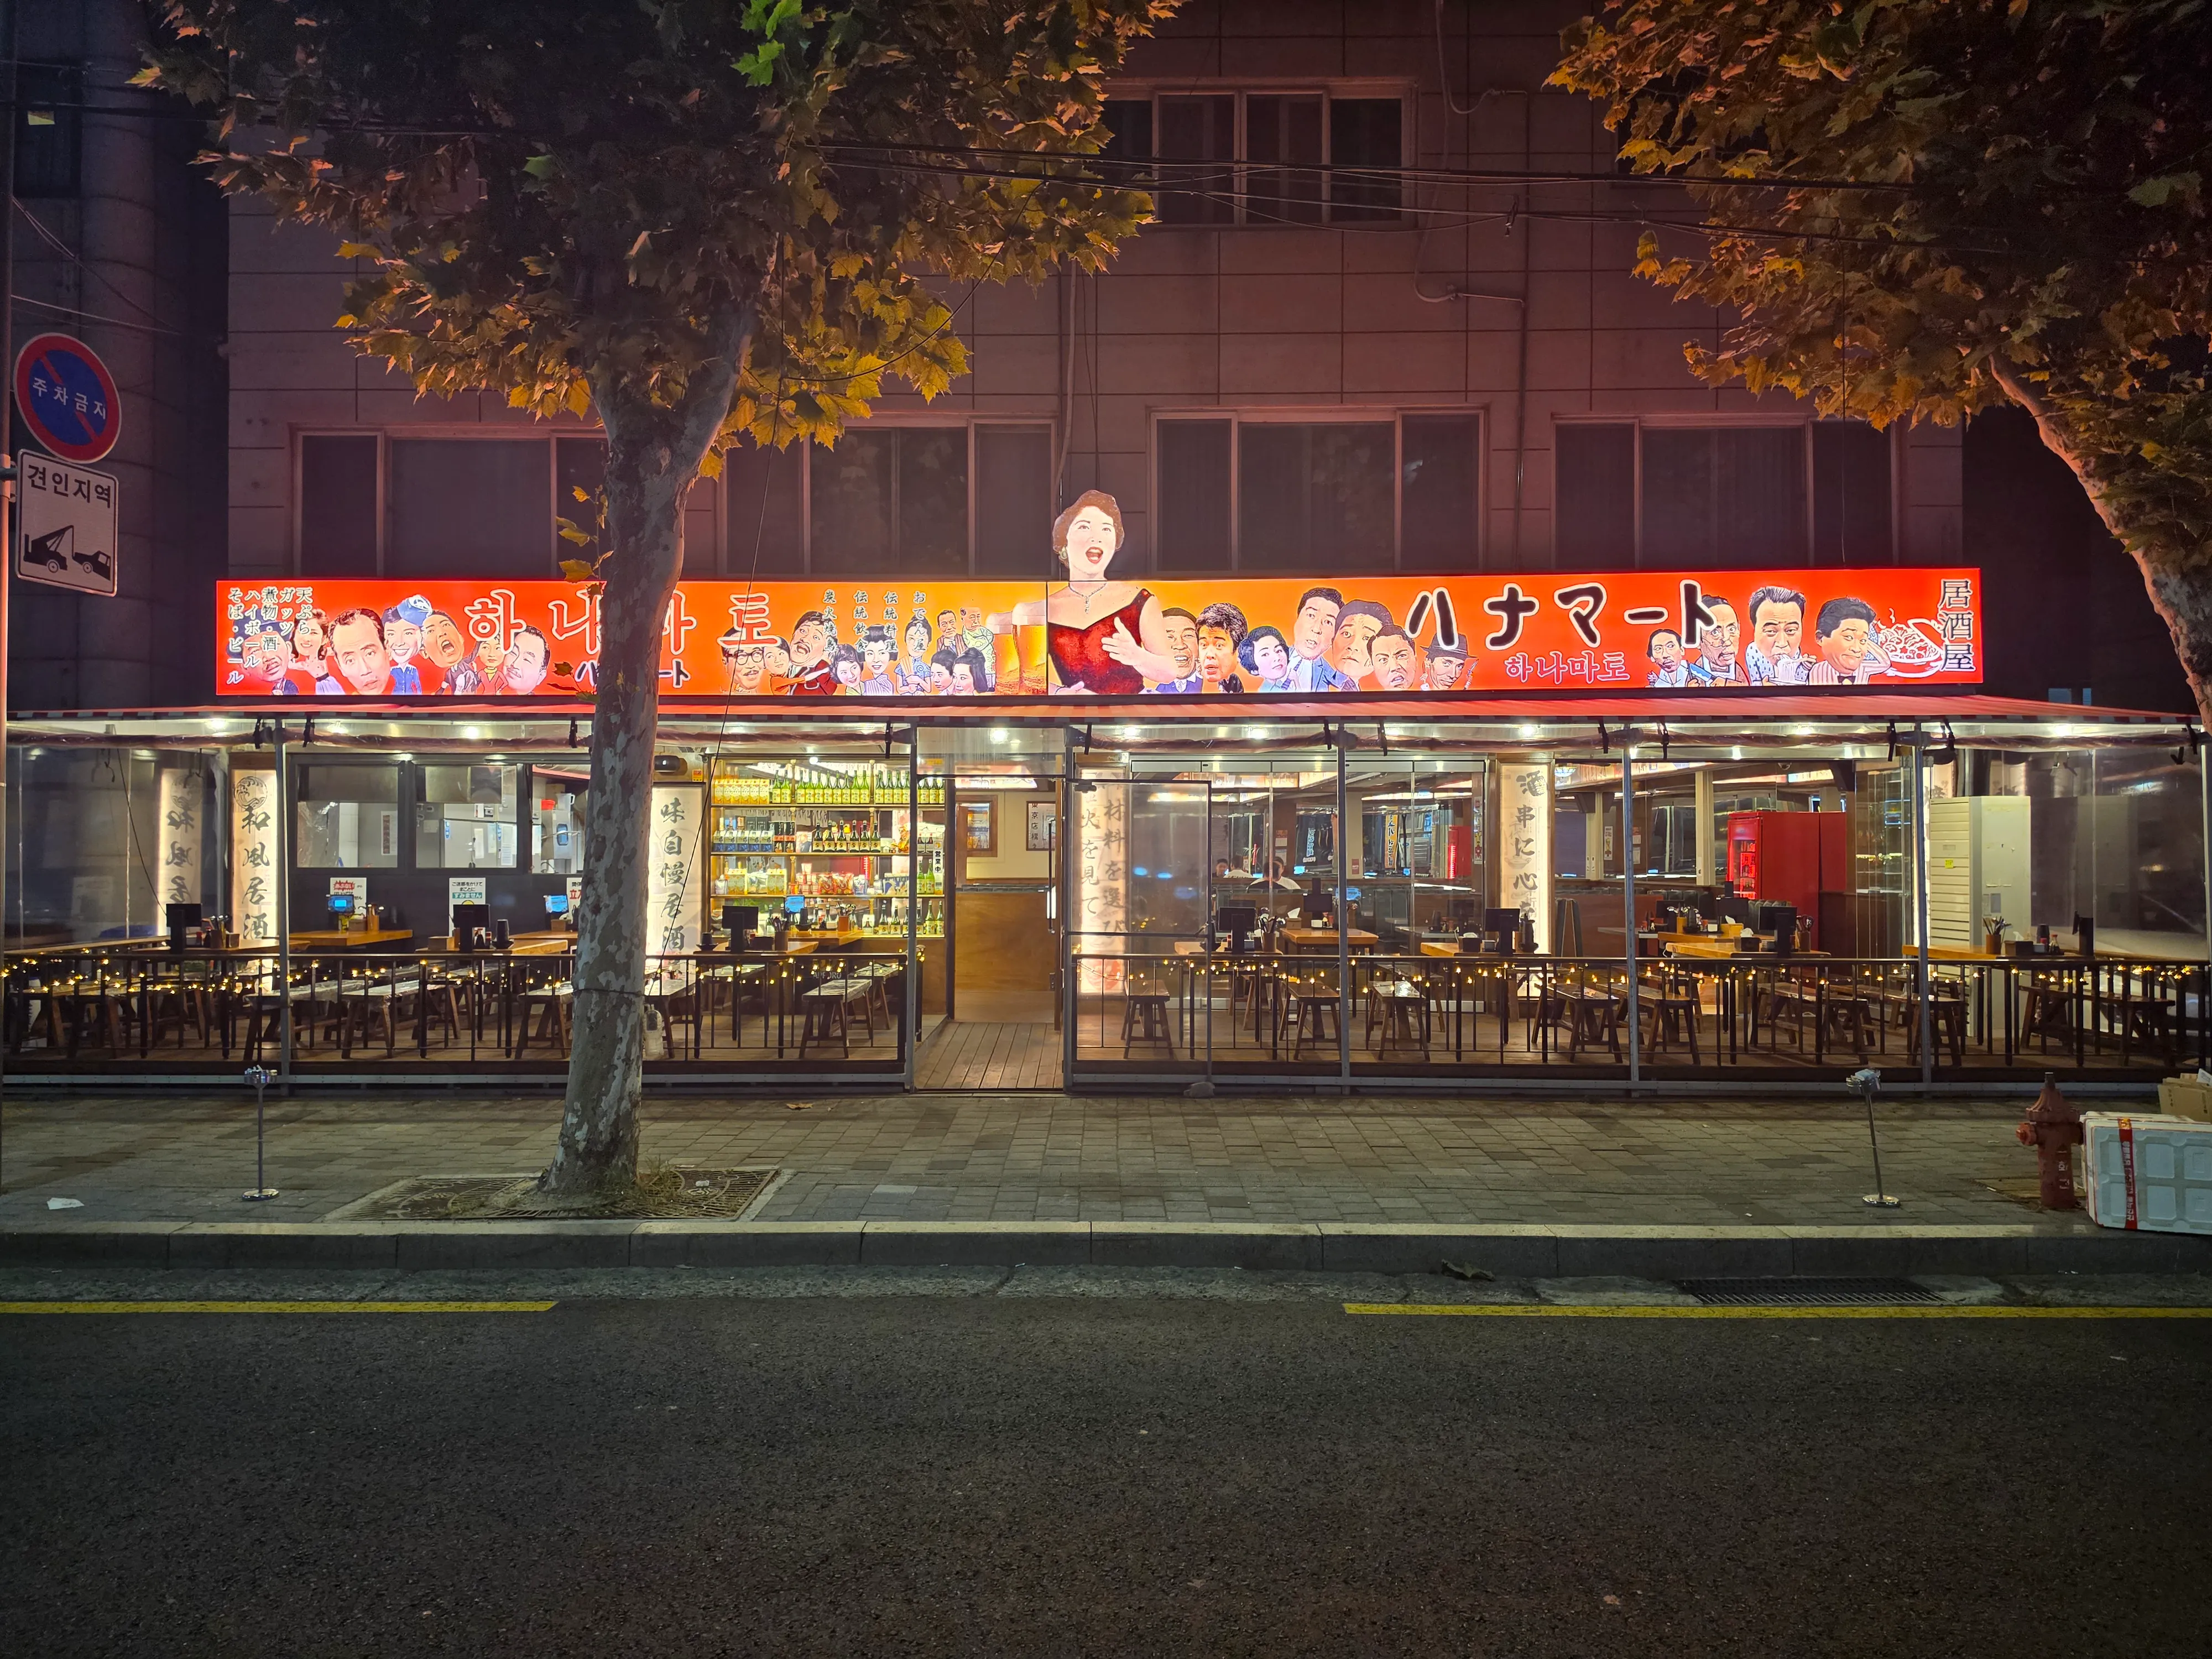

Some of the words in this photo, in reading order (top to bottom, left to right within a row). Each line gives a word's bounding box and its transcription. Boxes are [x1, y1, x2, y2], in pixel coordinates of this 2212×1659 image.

[32, 377, 107, 420] 주차금지
[27, 465, 111, 508] 견인지역
[244, 589, 260, 668] ハイボール
[296, 587, 313, 635] 天ぷら
[465, 588, 782, 655] 하나토
[883, 591, 899, 653] 伝統料理
[912, 591, 927, 651] おでん屋
[1405, 579, 1718, 649] ハナマート
[1938, 578, 1976, 672] 居酒屋
[1505, 650, 1630, 685] 하나마토
